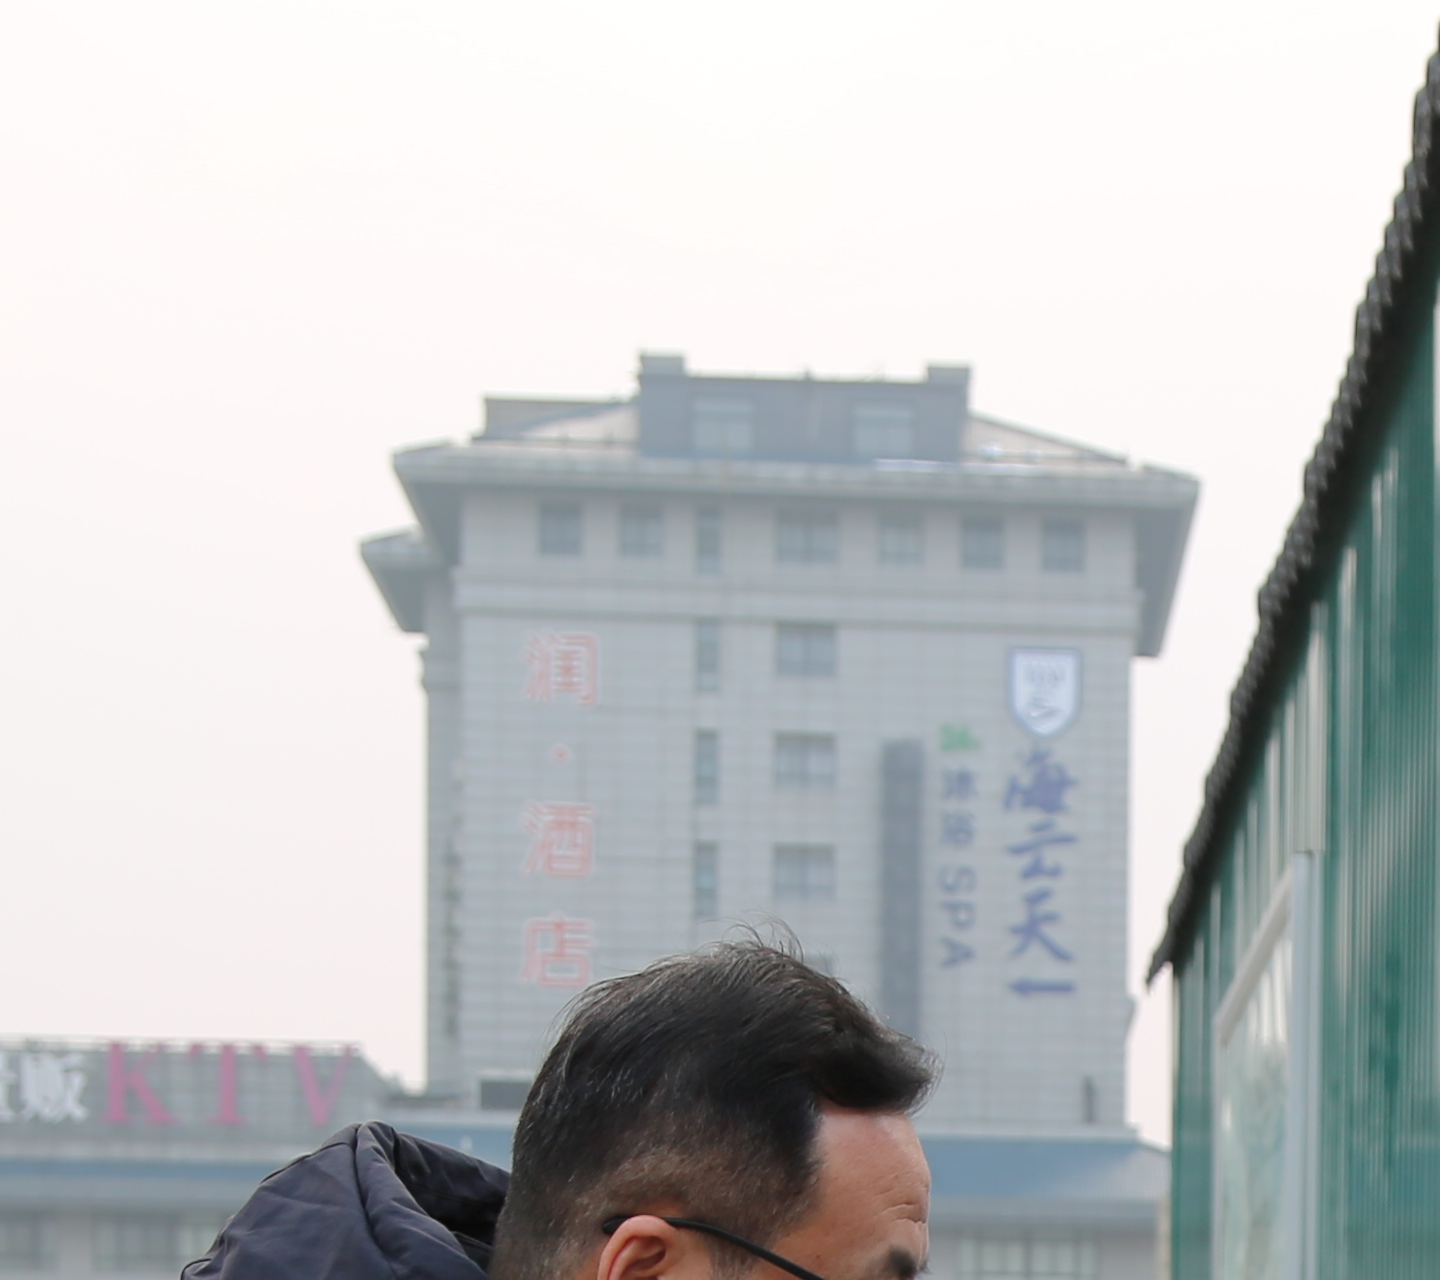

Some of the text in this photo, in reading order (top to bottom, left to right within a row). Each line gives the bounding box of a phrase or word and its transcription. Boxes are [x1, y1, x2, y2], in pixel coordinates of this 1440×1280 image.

[1003, 745, 1079, 962] 海云天
[103, 1042, 360, 1126] KTV
